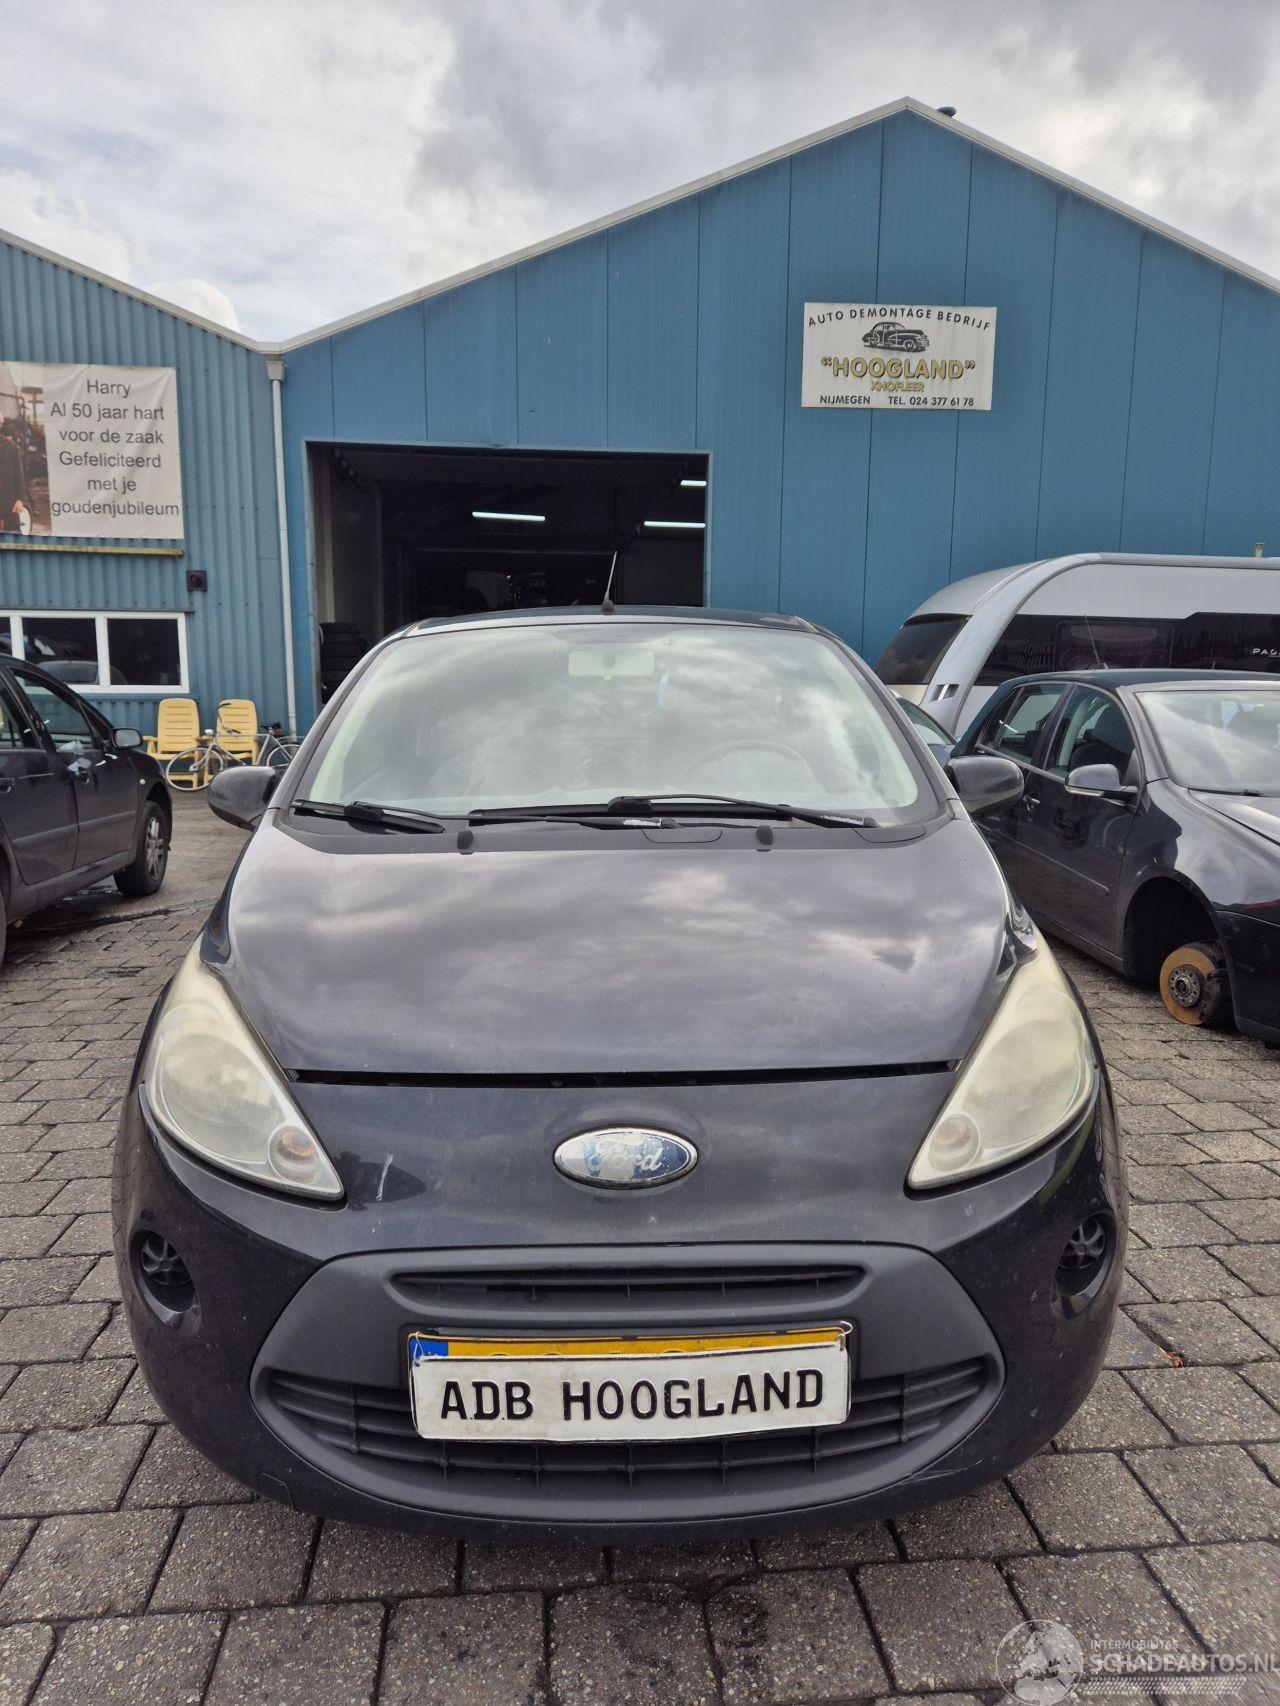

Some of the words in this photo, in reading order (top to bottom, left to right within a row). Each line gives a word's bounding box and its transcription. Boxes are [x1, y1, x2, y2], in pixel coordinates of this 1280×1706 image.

[808, 310, 844, 327] AUTO
[849, 307, 932, 319] DEMONTAGE
[937, 311, 991, 331] BEDRIJF
[86, 379, 131, 398] Harry
[820, 395, 871, 405] NIJMEGEN
[888, 396, 906, 405] TEL.
[909, 396, 928, 406] 024
[931, 396, 948, 406] 377
[950, 397, 960, 406] 61
[963, 397, 974, 407] 78
[50, 402, 66, 417] Al
[72, 403, 92, 418] 50
[97, 406, 129, 422] jaar
[134, 405, 165, 420] hart
[59, 430, 95, 442] voor
[100, 429, 121, 443] de
[125, 430, 164, 444] zaak
[59, 451, 162, 468] Gefeliciteerd
[87, 477, 118, 491] met
[122, 478, 137, 494] je
[51, 501, 179, 518] goudenjubileum
[562, 1368, 824, 1421] HOOGLAND
